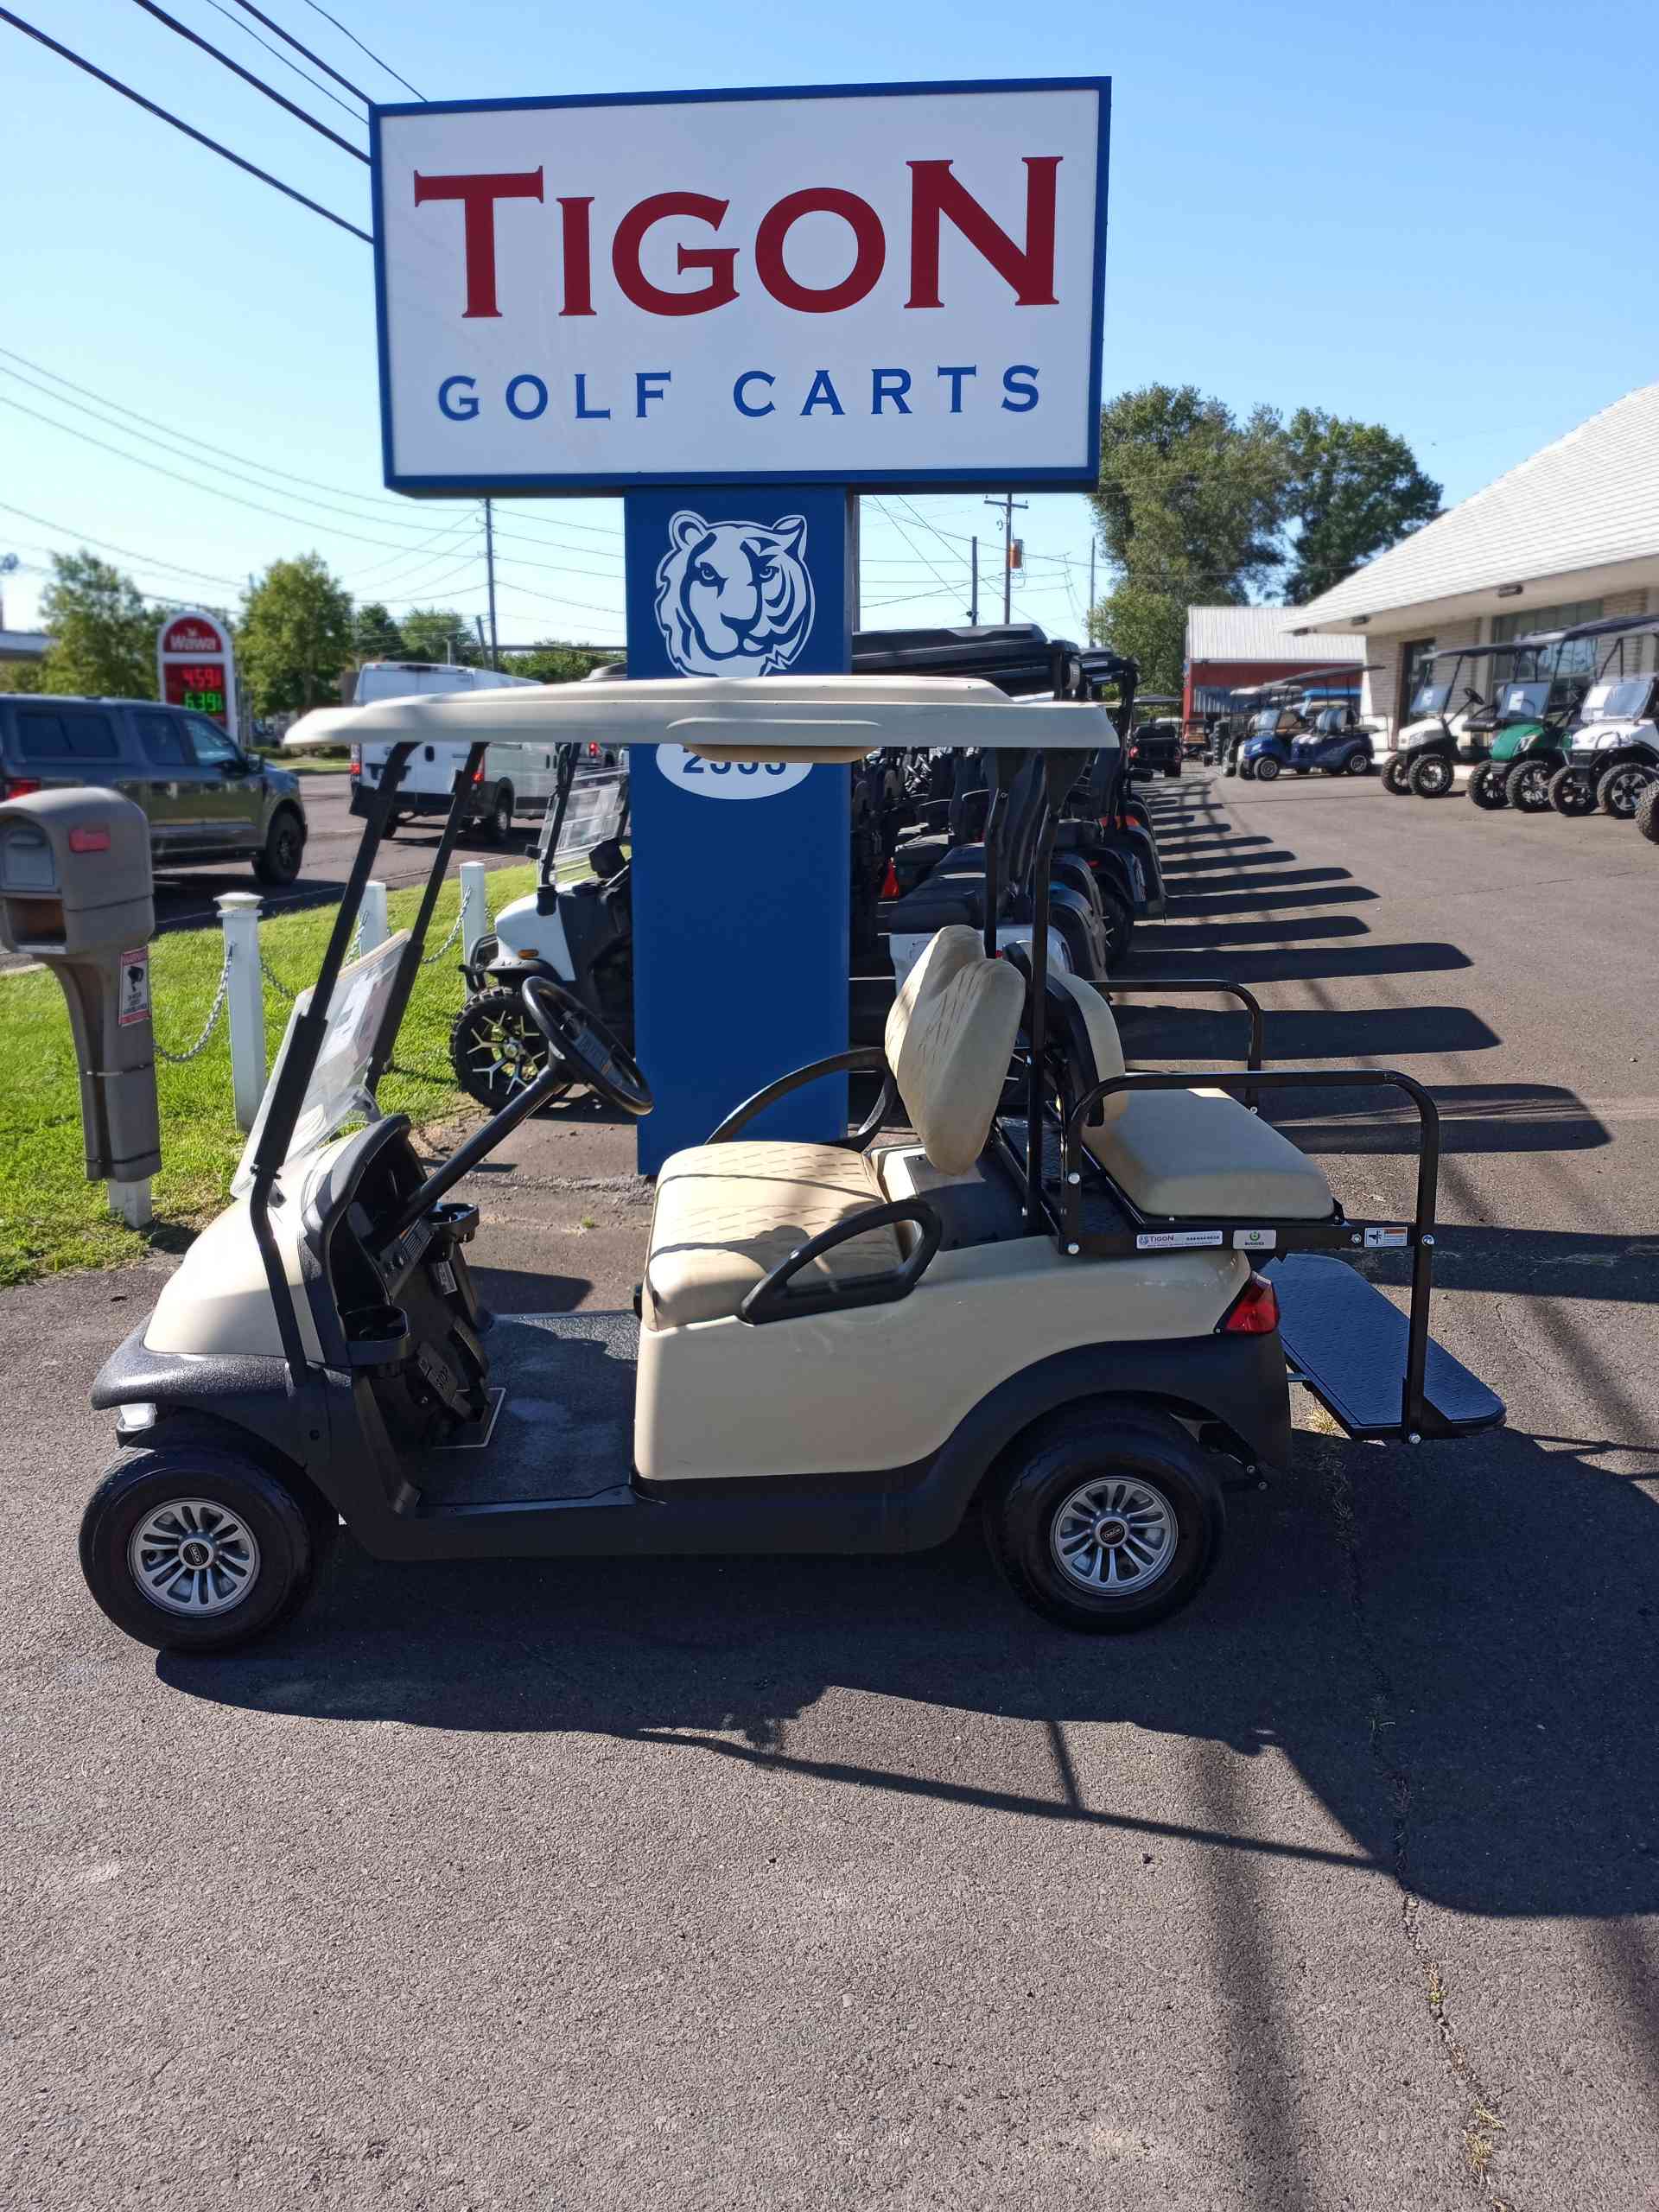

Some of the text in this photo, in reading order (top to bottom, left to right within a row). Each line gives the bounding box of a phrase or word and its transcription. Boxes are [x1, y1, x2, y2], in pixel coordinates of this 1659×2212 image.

[414, 156, 1064, 318] TIGON
[437, 364, 1040, 422] GOLF CARTS
[170, 635, 217, 651] Wawa
